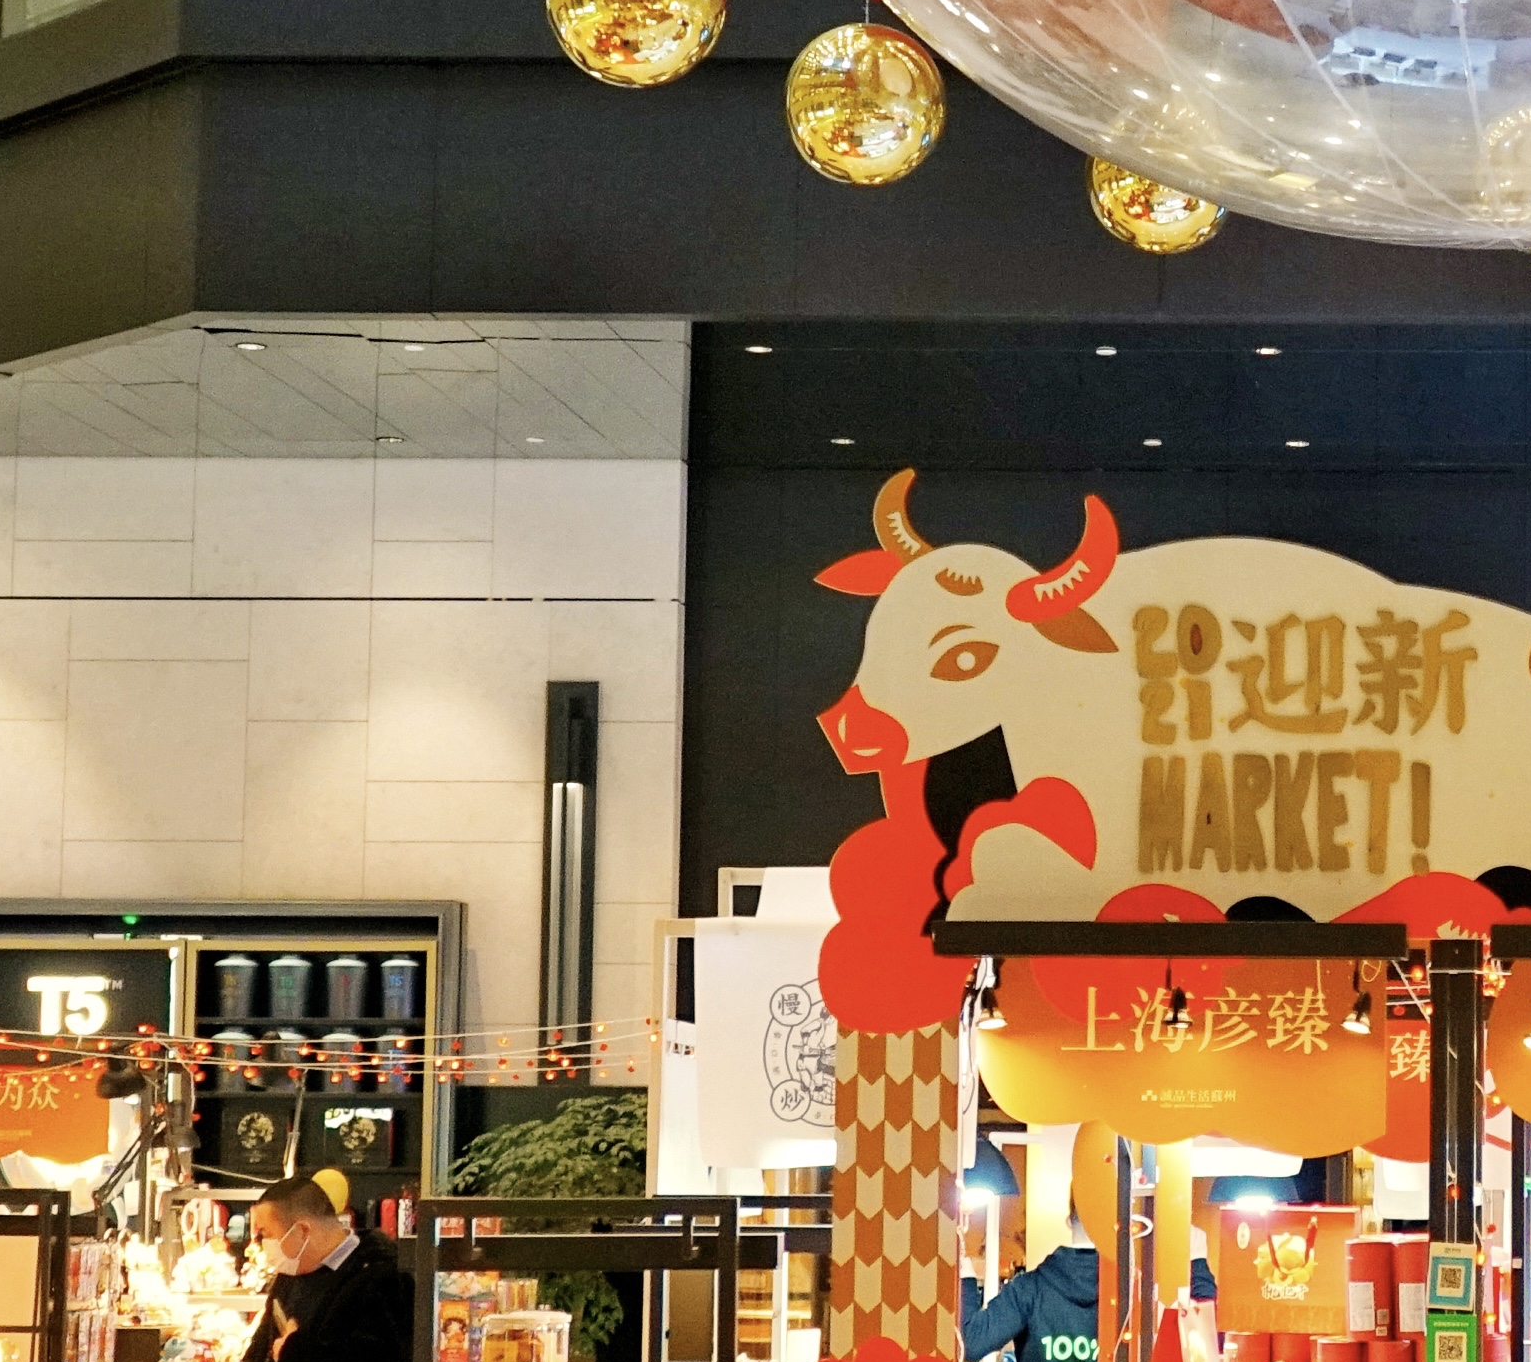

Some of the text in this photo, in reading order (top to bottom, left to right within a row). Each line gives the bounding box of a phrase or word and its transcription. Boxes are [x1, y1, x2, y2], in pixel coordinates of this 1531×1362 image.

[1227, 607, 1477, 737] 迎新
[1138, 749, 1432, 877] MARKET!
[27, 975, 108, 1036] T5
[777, 992, 803, 1017] 慢
[1060, 986, 1332, 1056] 上海彦臻
[780, 1088, 805, 1112] 炒
[1160, 1089, 1237, 1103] 誠品生活蘇州
